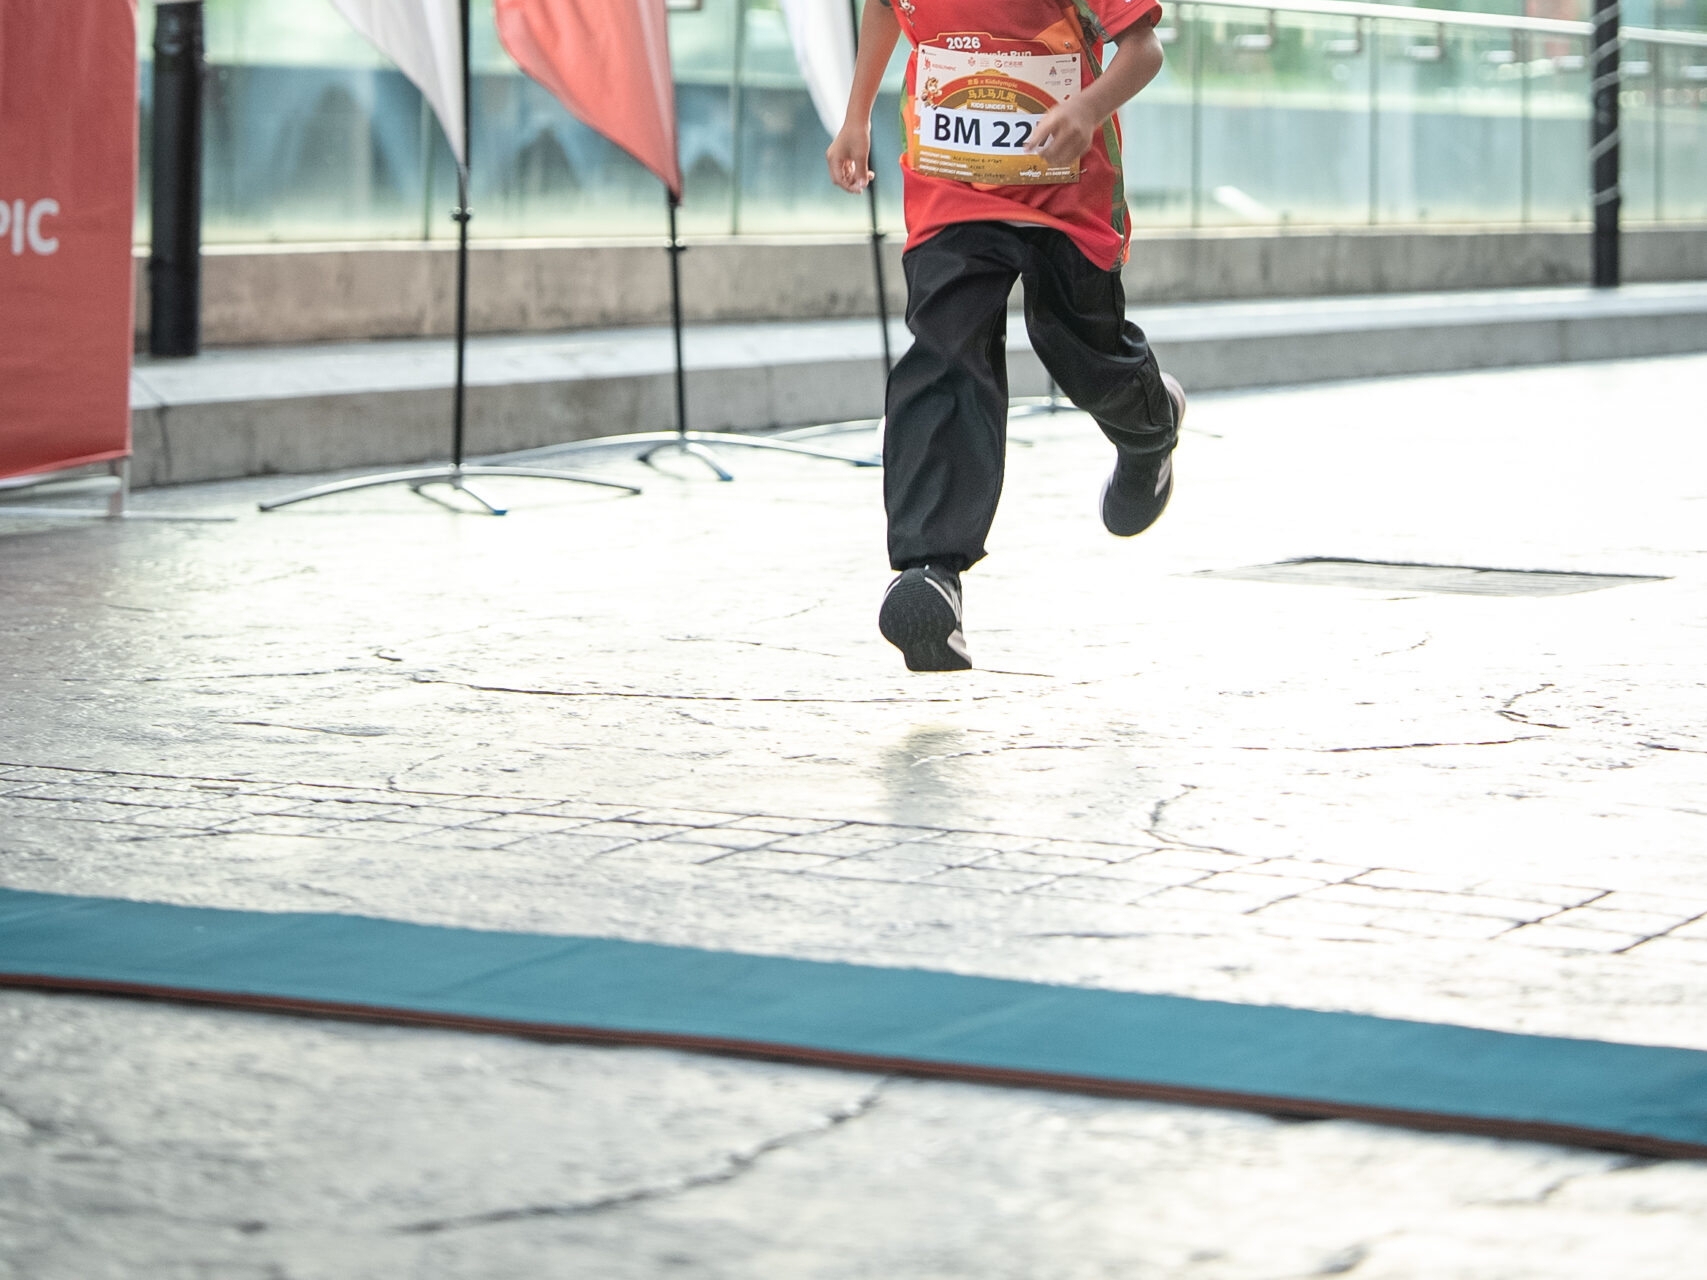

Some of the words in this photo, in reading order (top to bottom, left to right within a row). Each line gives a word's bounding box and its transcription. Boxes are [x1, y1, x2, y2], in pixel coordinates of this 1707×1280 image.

[946, 36, 981, 50] 2026
[968, 89, 1017, 103] 马儿马儿跑
[934, 113, 981, 146] BM
[992, 121, 1051, 148] 22
